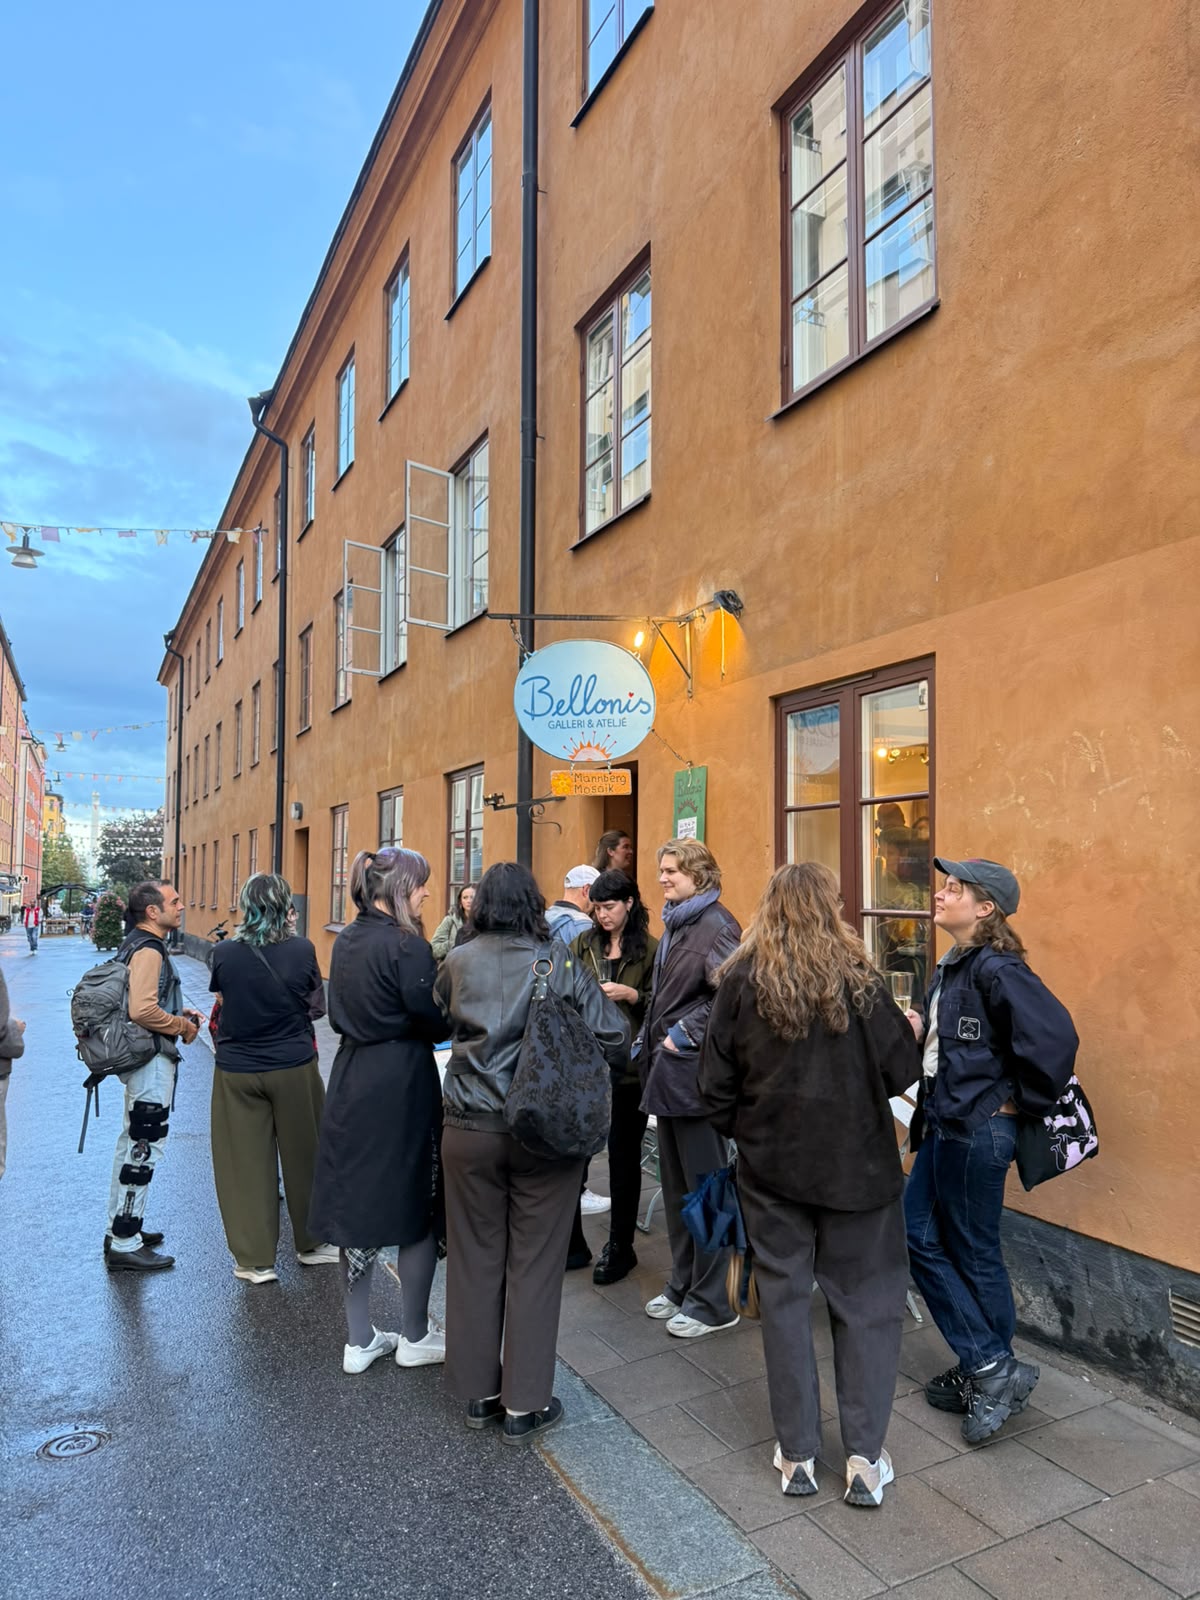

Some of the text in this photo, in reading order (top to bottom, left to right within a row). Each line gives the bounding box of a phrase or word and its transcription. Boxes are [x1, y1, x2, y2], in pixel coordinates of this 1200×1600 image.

[521, 674, 651, 720] Bellonis
[548, 717, 627, 729] GALLERI & ATELJÉ
[574, 773, 626, 785] Mannberg
[574, 784, 614, 794] Mosaik
